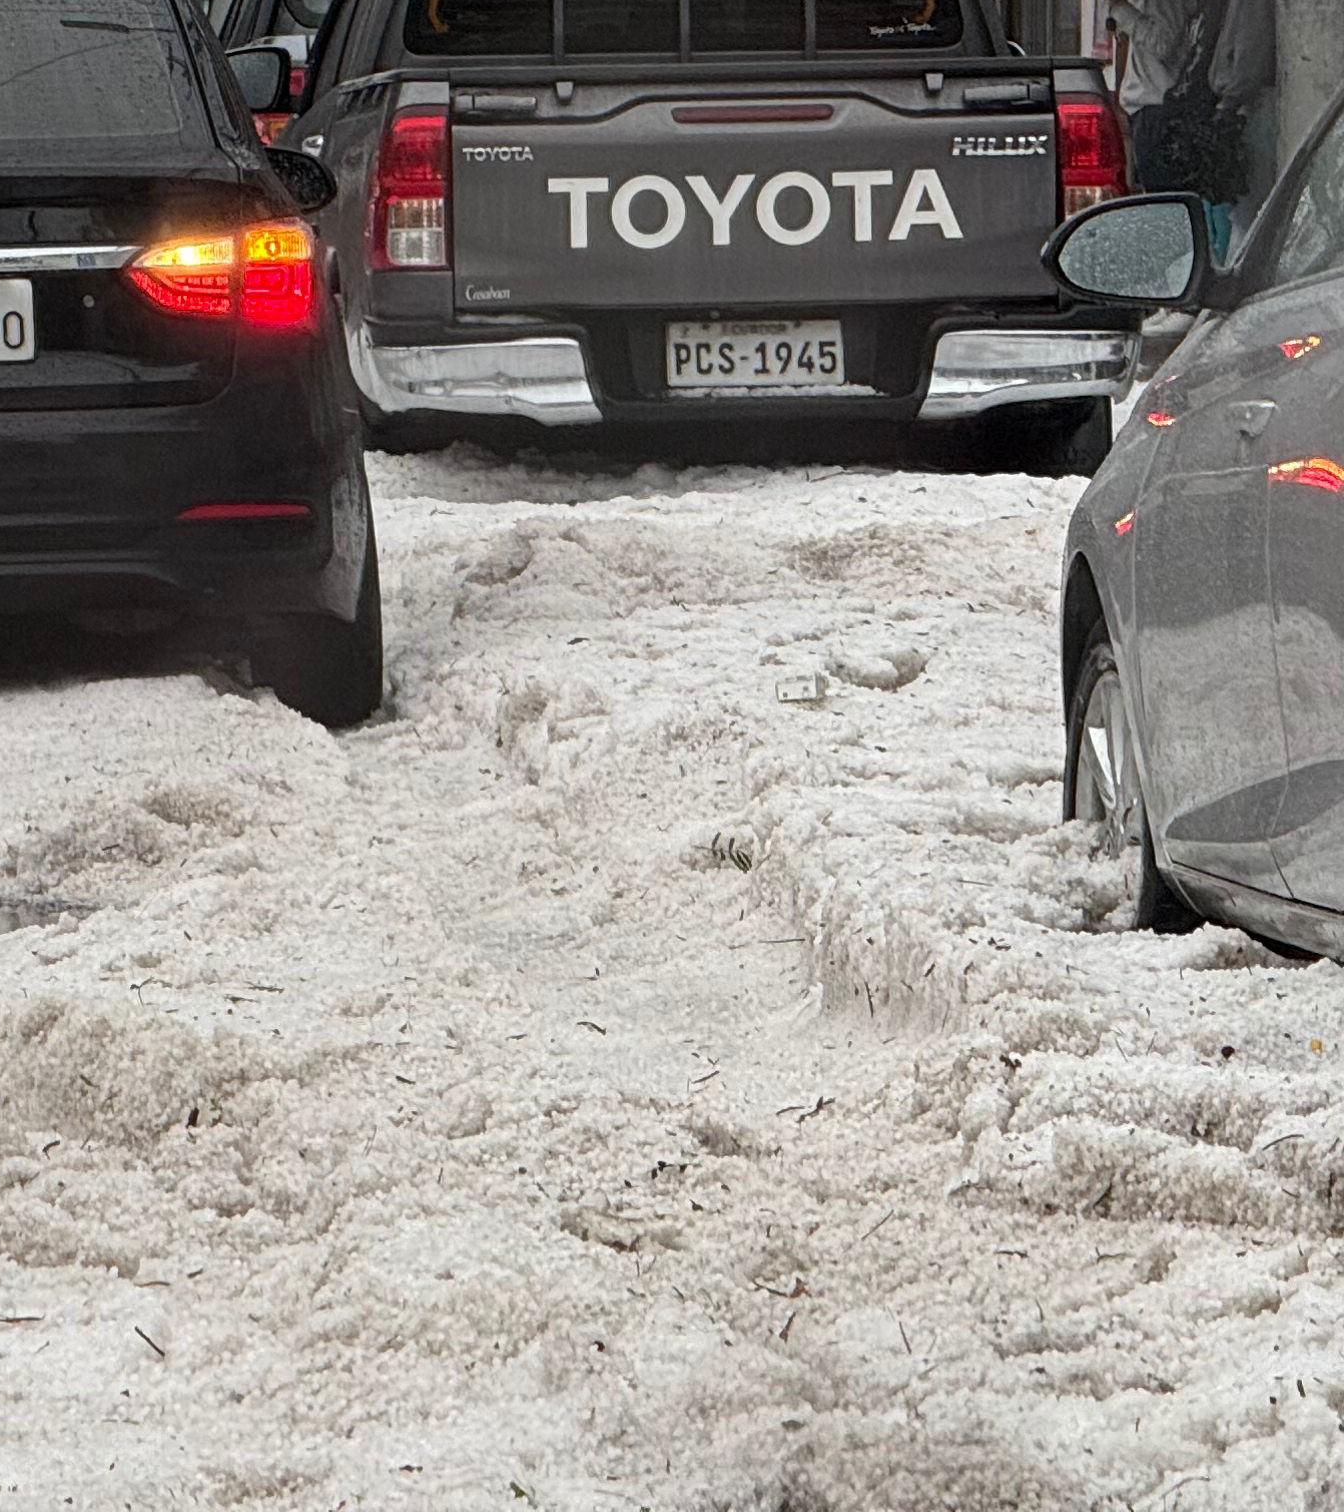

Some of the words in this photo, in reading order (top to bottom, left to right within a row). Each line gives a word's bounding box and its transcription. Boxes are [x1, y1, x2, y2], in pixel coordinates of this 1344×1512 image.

[462, 146, 534, 162] TOYOTA
[951, 135, 1048, 156] HILUX
[548, 168, 964, 249] TOYOTA
[674, 341, 837, 376] PCS-1945
